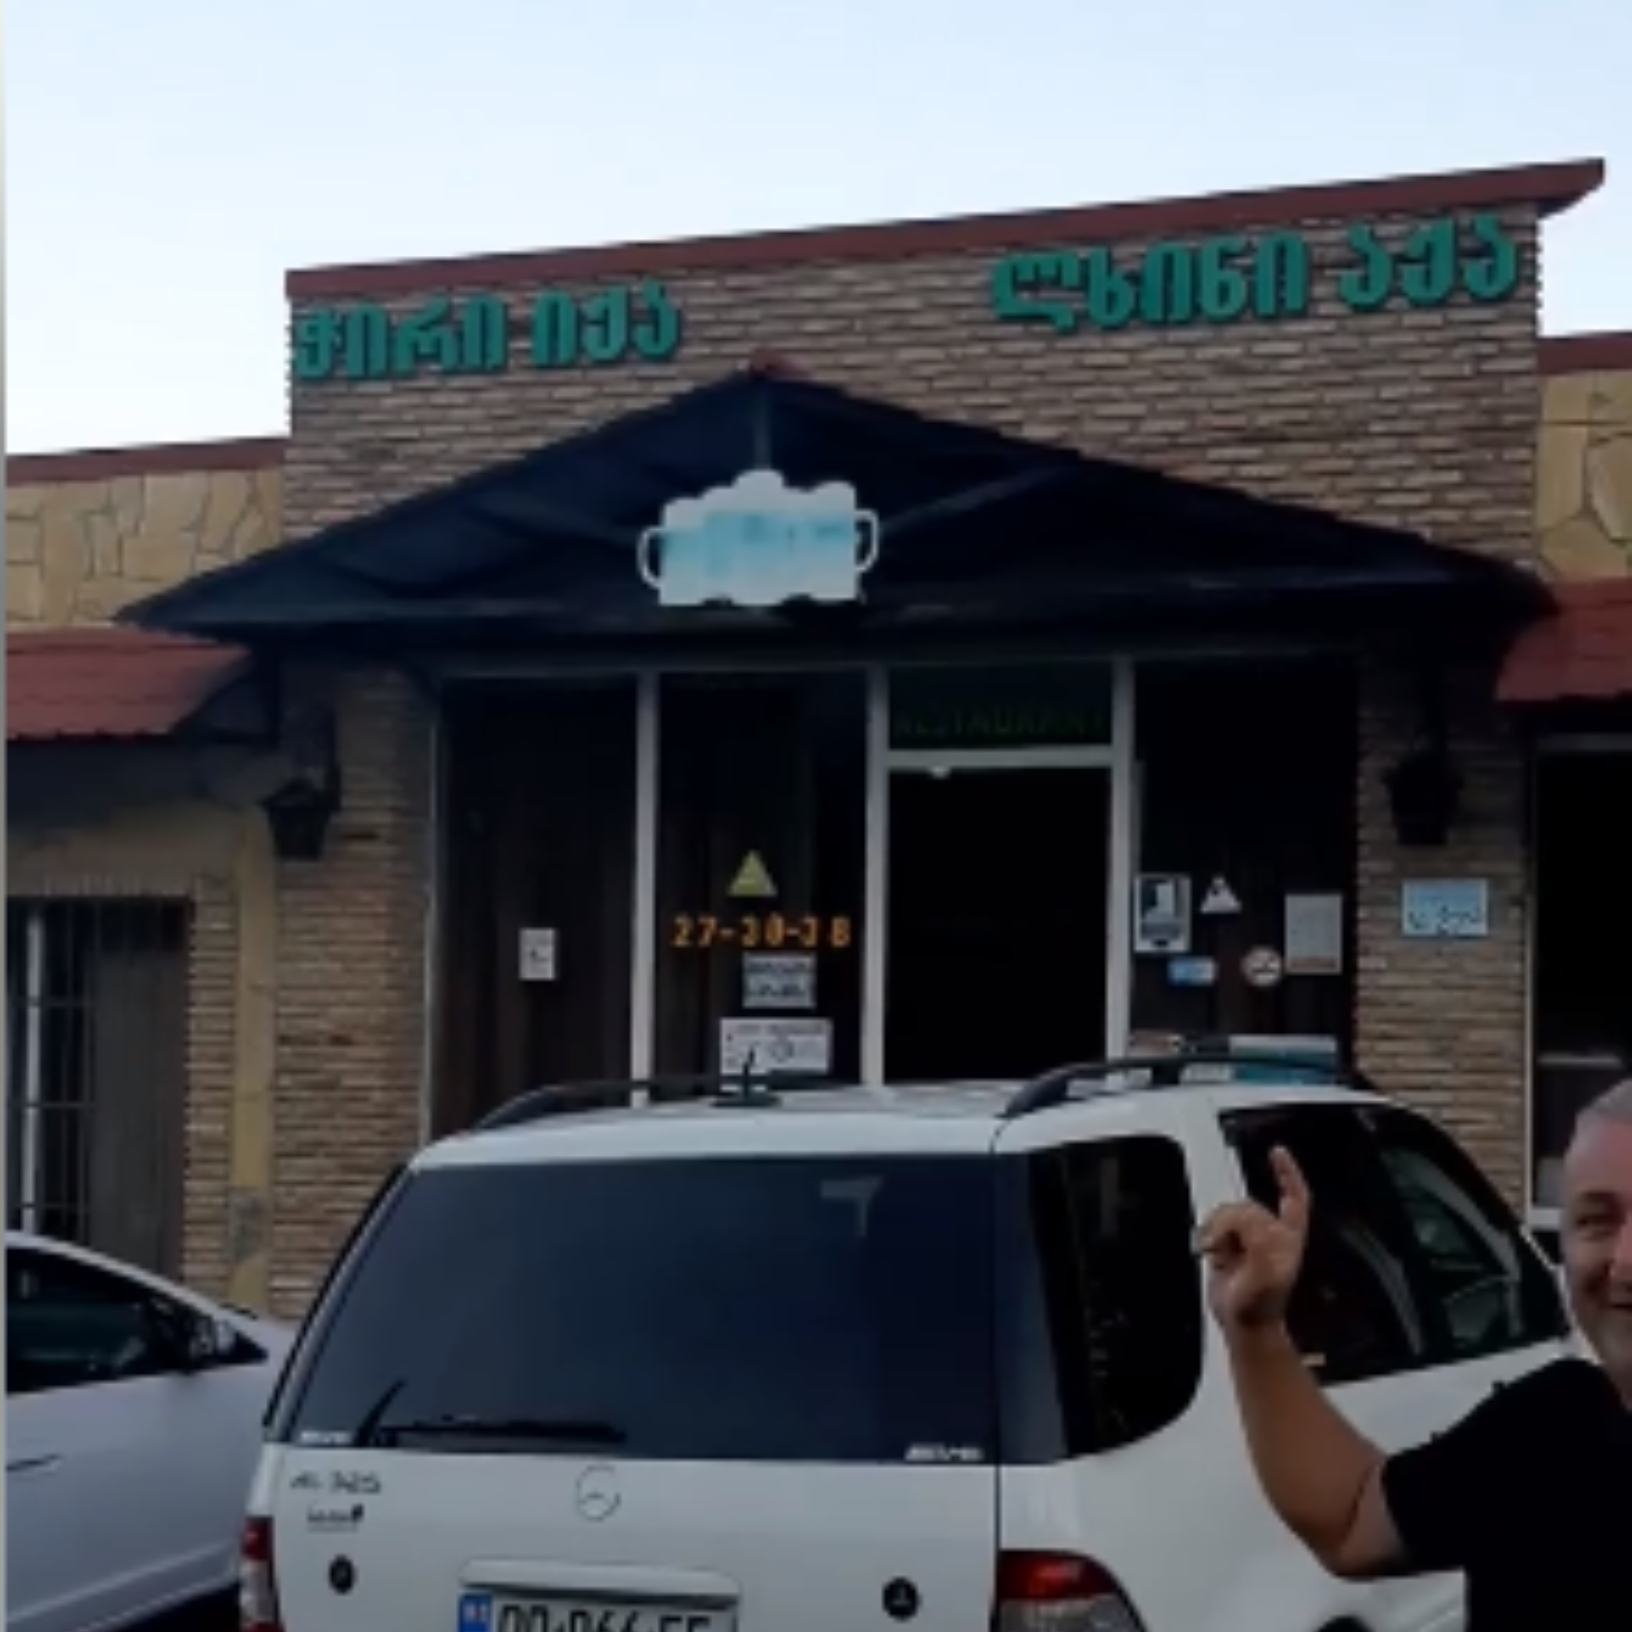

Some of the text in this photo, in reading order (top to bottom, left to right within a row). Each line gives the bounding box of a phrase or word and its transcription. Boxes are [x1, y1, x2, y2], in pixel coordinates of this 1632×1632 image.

[990, 211, 1518, 331] ლხინი აქა
[294, 277, 682, 381] ჭირი იქა
